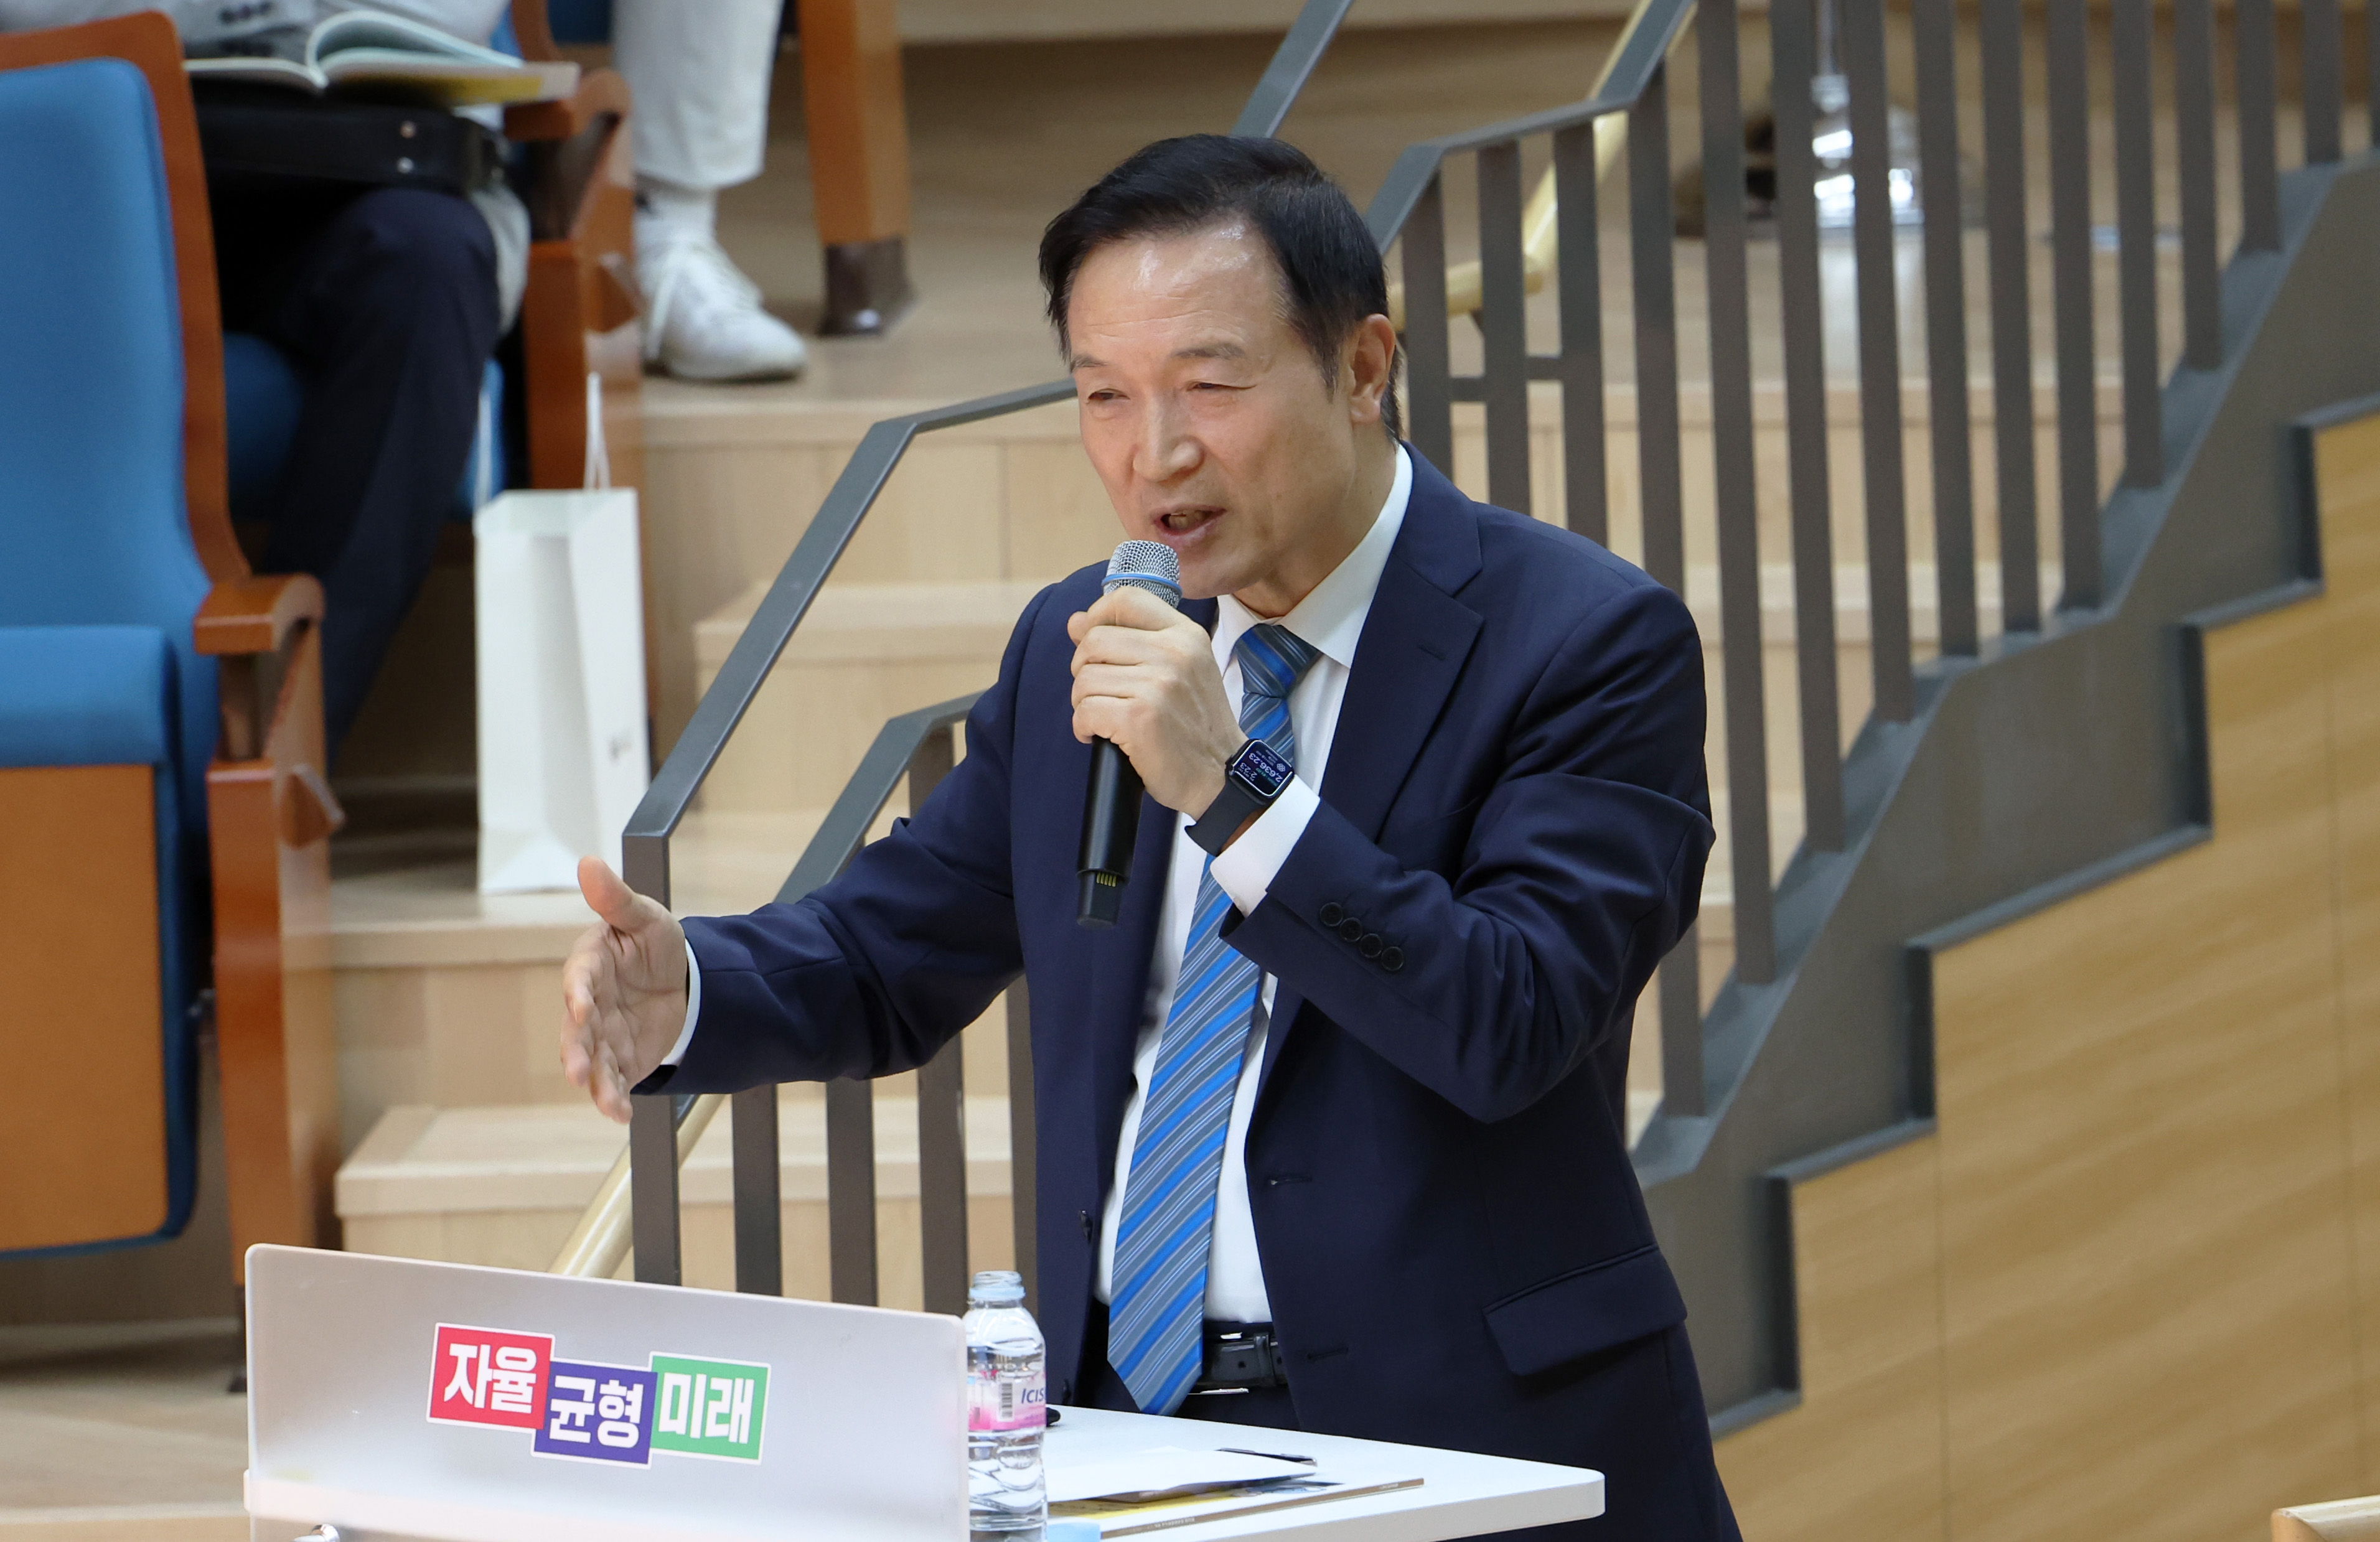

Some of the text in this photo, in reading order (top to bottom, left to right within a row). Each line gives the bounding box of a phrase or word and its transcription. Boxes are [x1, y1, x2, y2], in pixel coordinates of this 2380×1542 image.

[1249, 752, 1283, 782] 2,636.23
[444, 1343, 754, 1448] 자율 균형 미래
